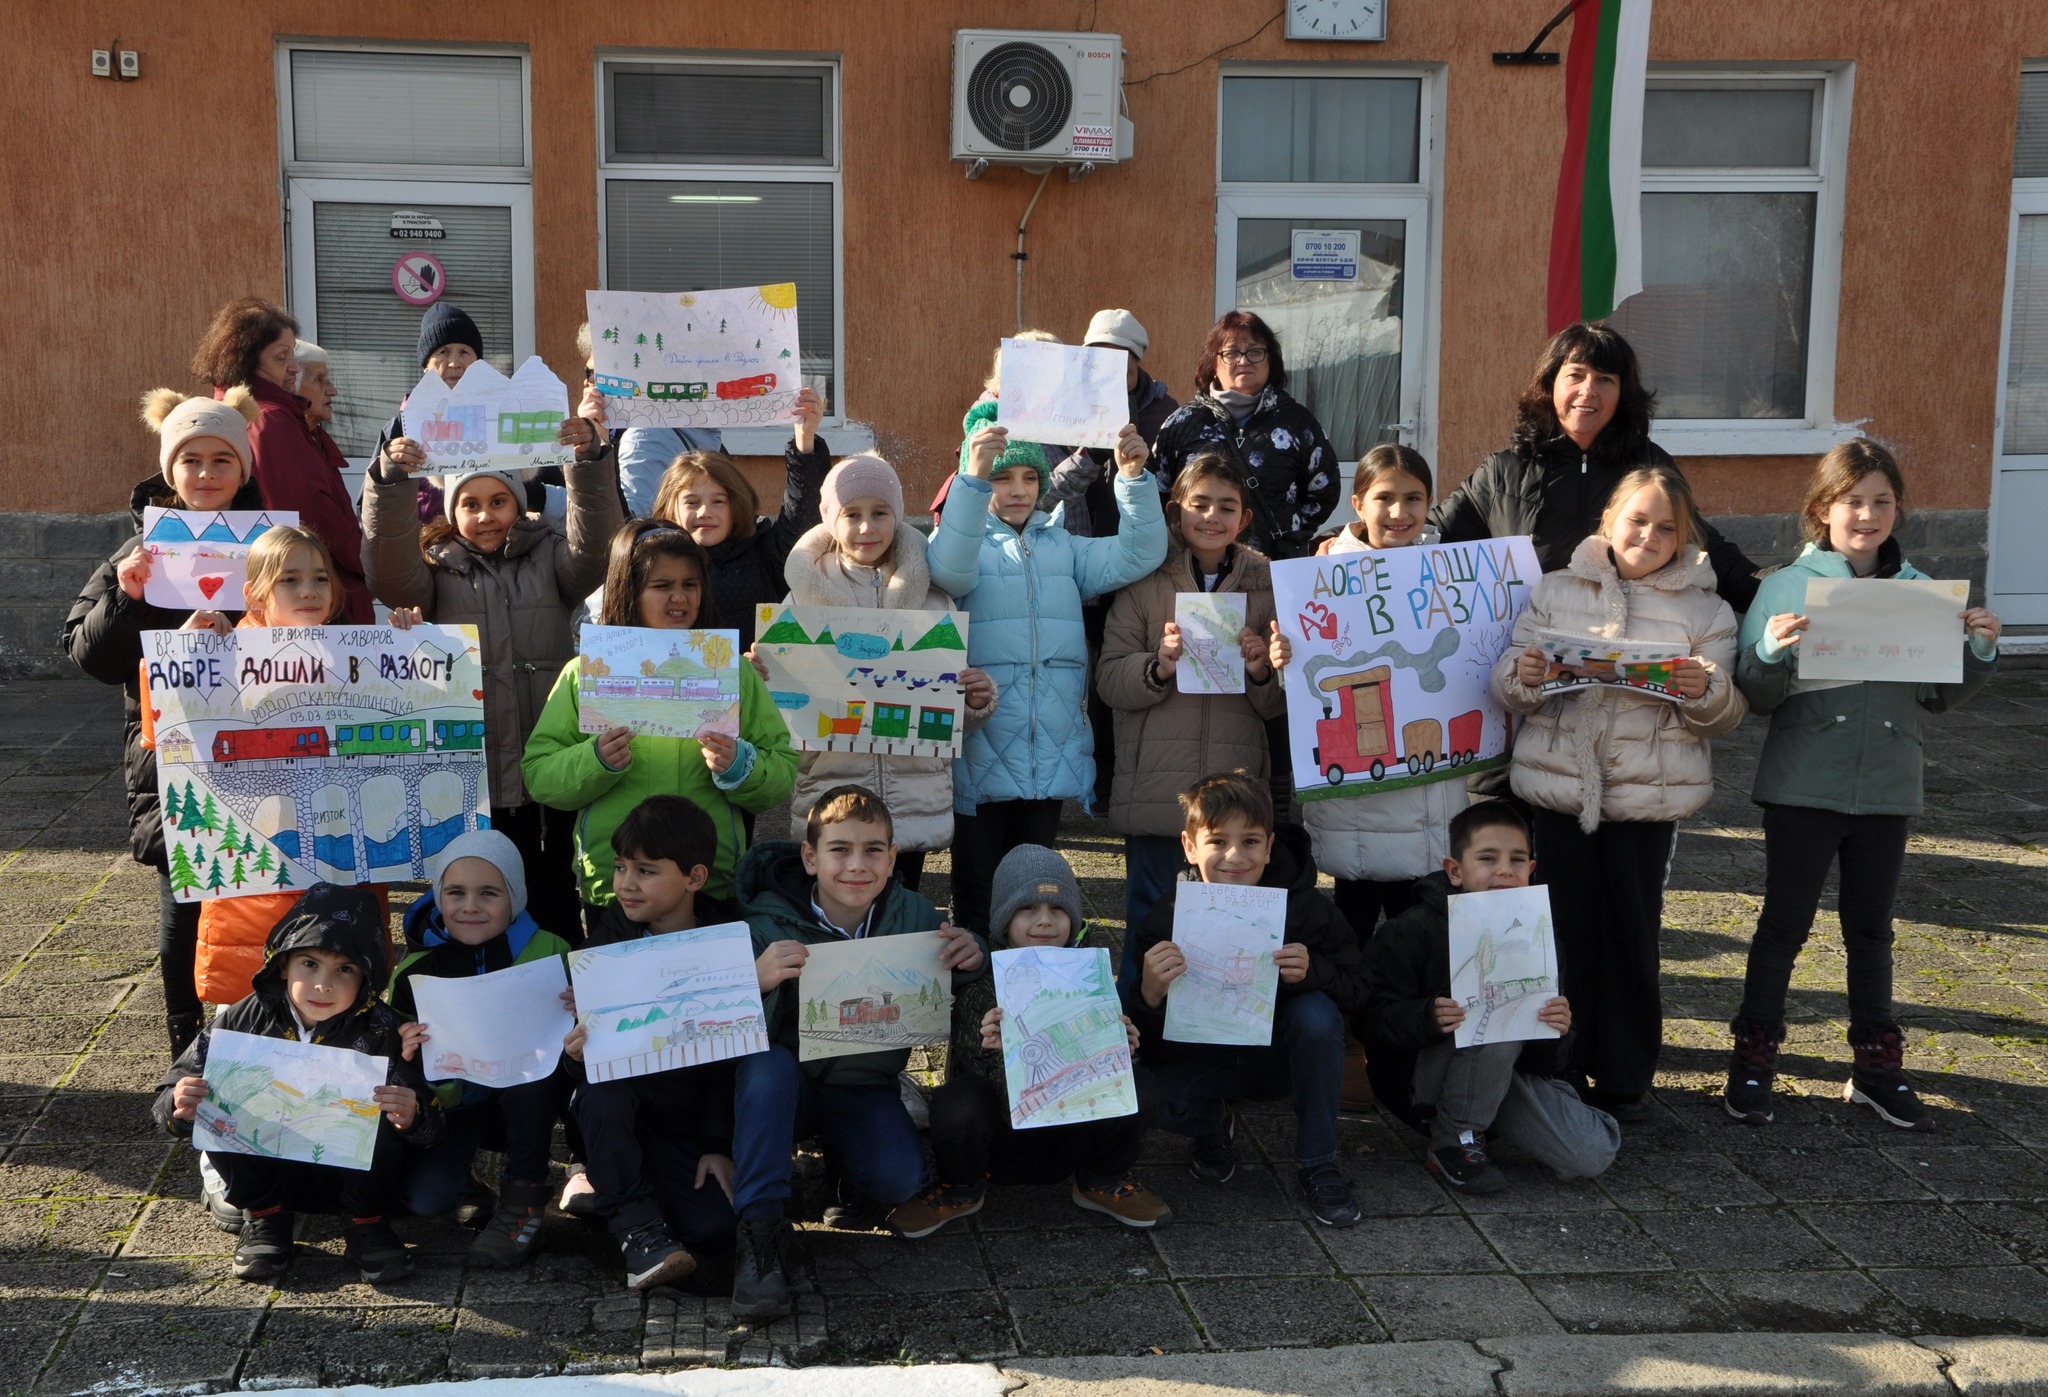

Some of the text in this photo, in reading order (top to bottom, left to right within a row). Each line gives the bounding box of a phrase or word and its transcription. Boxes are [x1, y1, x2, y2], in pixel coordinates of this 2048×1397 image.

[1075, 126, 1112, 135] VIMAX
[409, 230, 423, 238] 940
[424, 230, 443, 238] 9400
[1305, 242, 1346, 251] 0700 10 200
[1313, 542, 1518, 600] ДОБРЕ ДОШЛИ
[1366, 579, 1524, 635] В РАЗЛОГ
[1298, 600, 1330, 641] АЗ
[179, 631, 242, 655] ТОДОРКА.
[149, 652, 454, 691] ДОБРЕ ДОШЛИ В РАЗЛОГ!
[1201, 884, 1280, 900] ДОБРЕ ДОШЛИ
[1225, 896, 1273, 910] РАЗЛОГ
